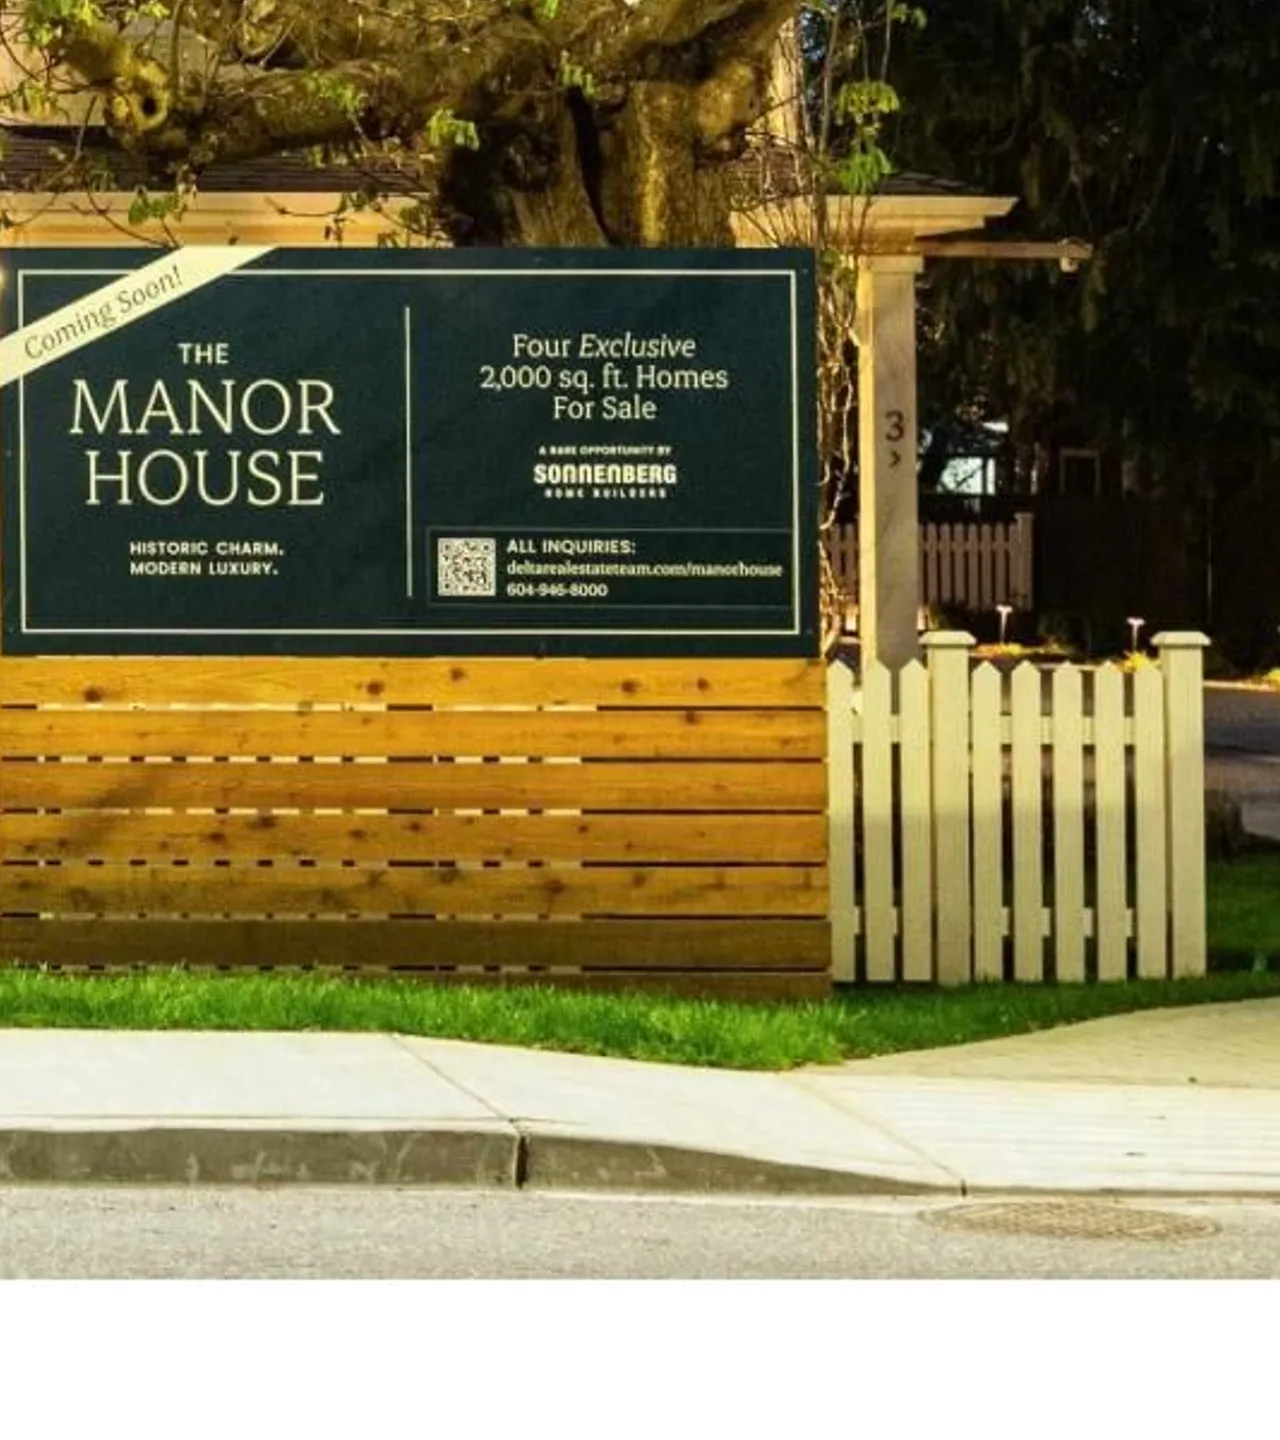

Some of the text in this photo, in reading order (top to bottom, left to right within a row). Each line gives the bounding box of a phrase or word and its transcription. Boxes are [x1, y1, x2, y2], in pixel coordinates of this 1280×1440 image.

[25, 264, 183, 359] Coming Soon!
[178, 342, 229, 364] THE
[513, 331, 696, 358] Four Exclusive
[479, 363, 729, 395] 2,000 sq. ft. Homes
[69, 378, 342, 436] MANOR
[553, 393, 657, 420] For Sale
[885, 410, 905, 441] 3
[84, 449, 325, 506] HOUSE
[533, 463, 677, 484] SONNENBERG
[130, 541, 284, 556] HISTORIC CHARM.
[506, 540, 637, 556] ALL INQUIRIES:
[130, 561, 279, 576] MODERN LUXURY.
